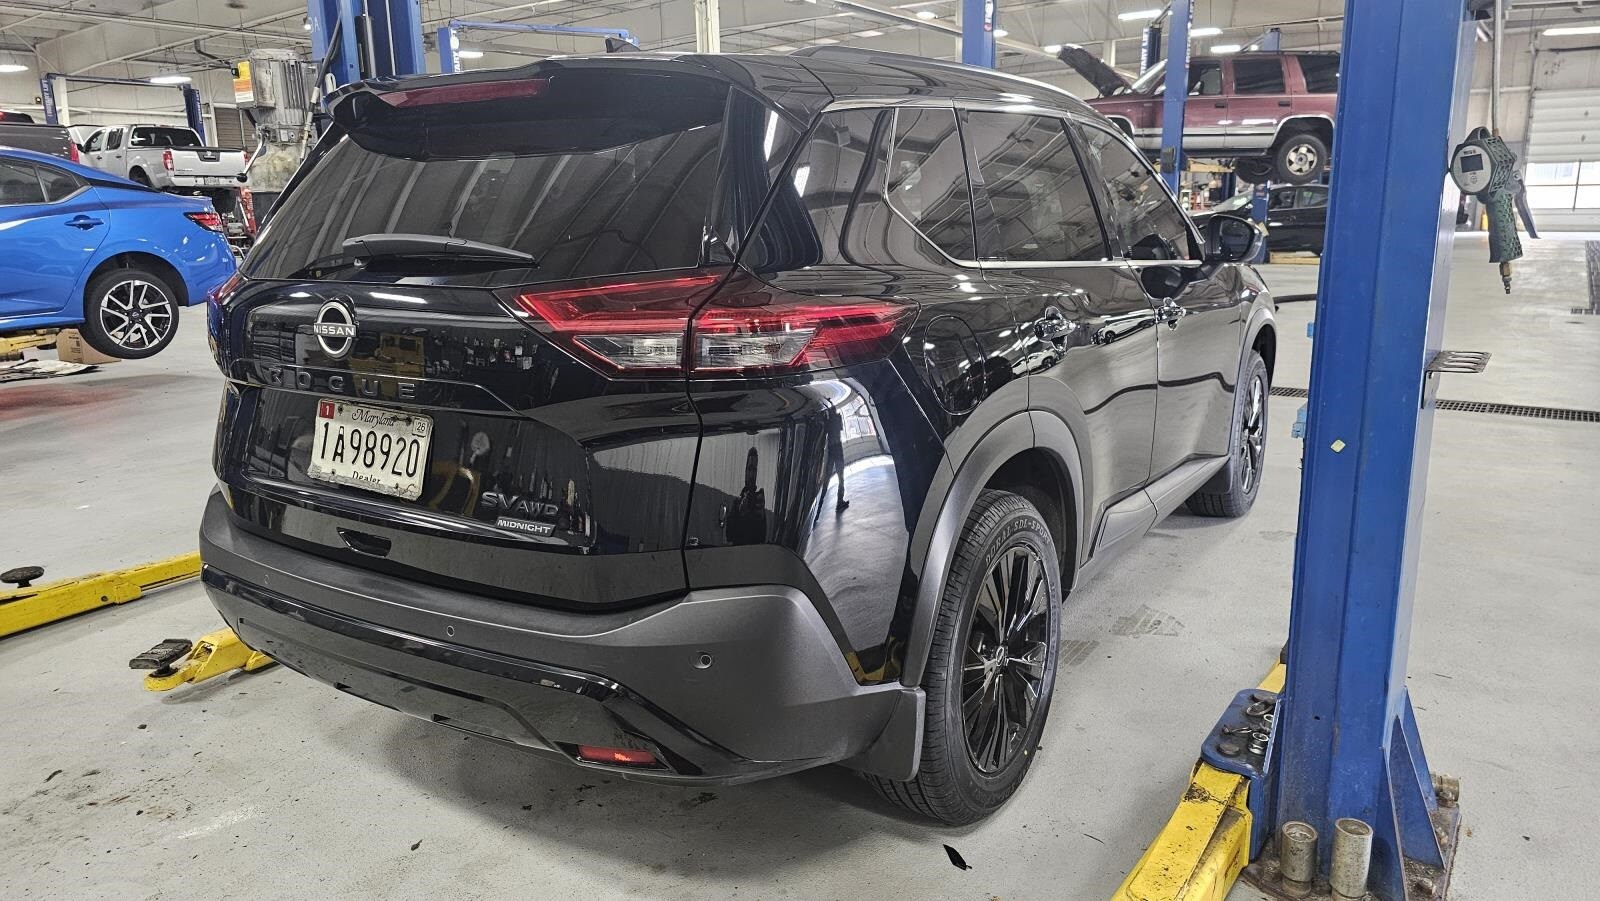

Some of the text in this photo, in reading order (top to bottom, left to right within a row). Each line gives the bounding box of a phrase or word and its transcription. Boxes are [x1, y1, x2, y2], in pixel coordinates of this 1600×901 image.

[313, 323, 355, 337] NISSAN
[268, 367, 416, 399] ROGUE
[351, 408, 395, 428] Maryland
[416, 422, 426, 432] 26
[320, 422, 421, 477] 1A98920
[352, 471, 381, 484] Dealer
[481, 491, 559, 516] SV AWD
[497, 519, 551, 534] MIDNIGHT
